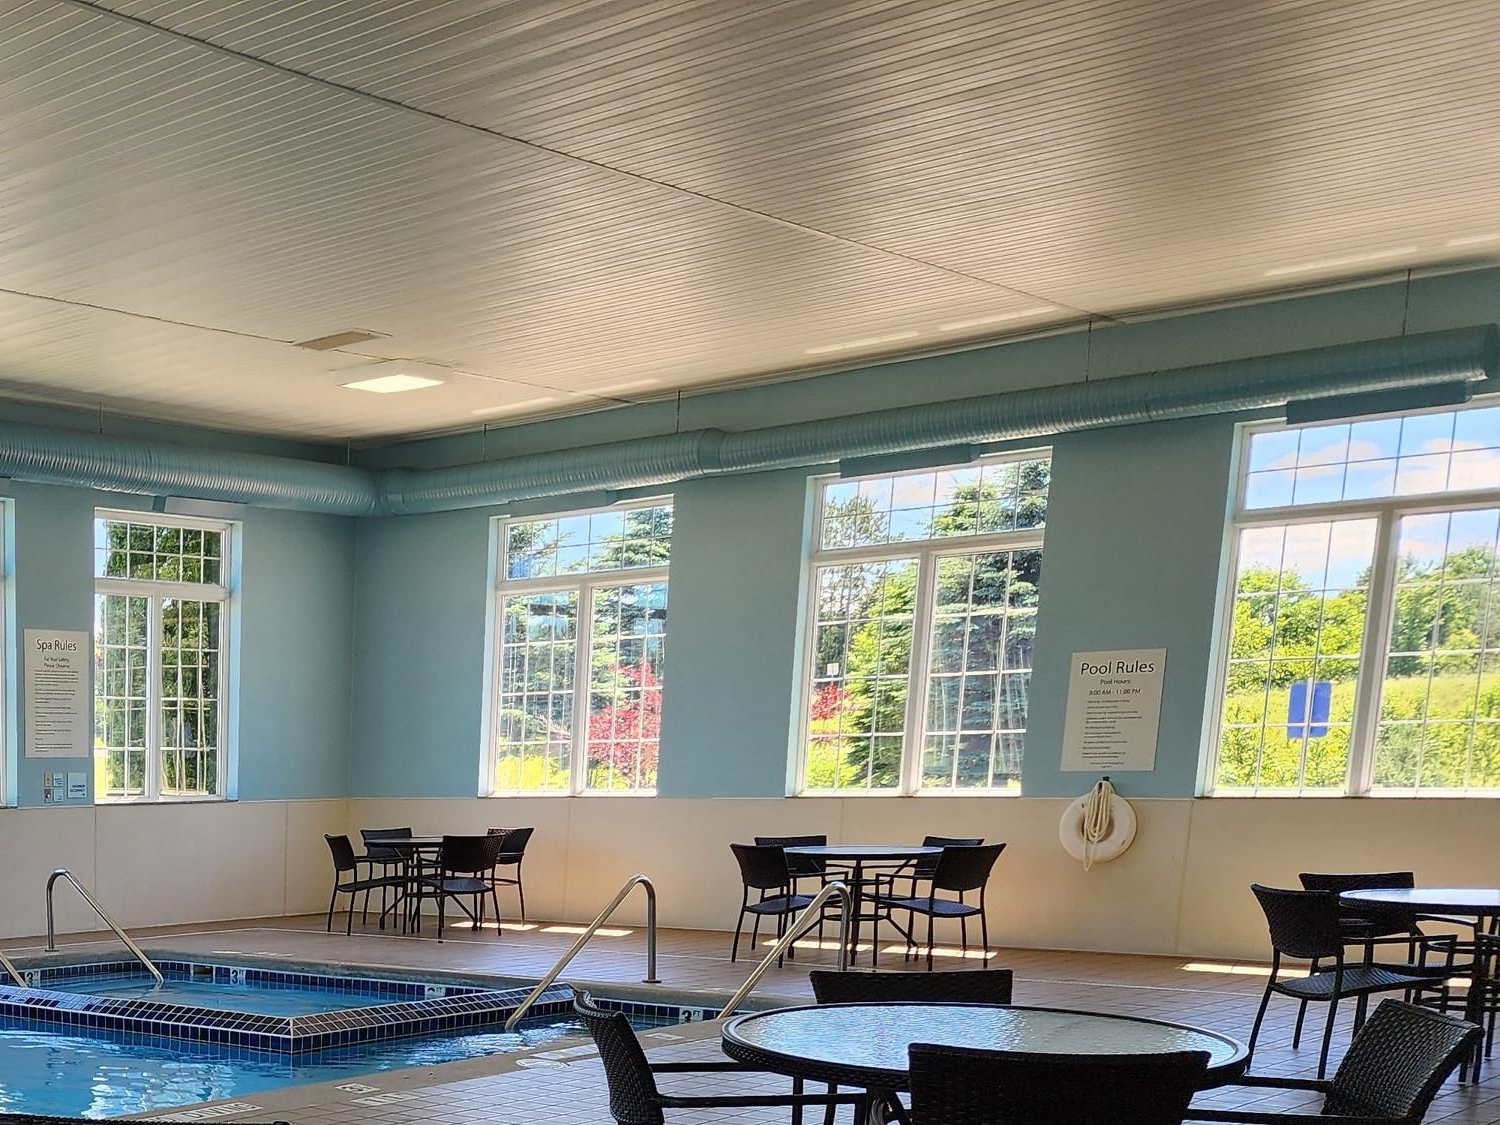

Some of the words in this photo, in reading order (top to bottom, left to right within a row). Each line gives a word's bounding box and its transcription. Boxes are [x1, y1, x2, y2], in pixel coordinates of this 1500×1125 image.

[36, 639, 52, 652] Spa
[54, 640, 77, 651] Rules
[1080, 661, 1112, 675] Pool
[1116, 660, 1155, 674] Rules
[692, 1010, 701, 1018] FT
[181, 1103, 257, 1119] DIVING
